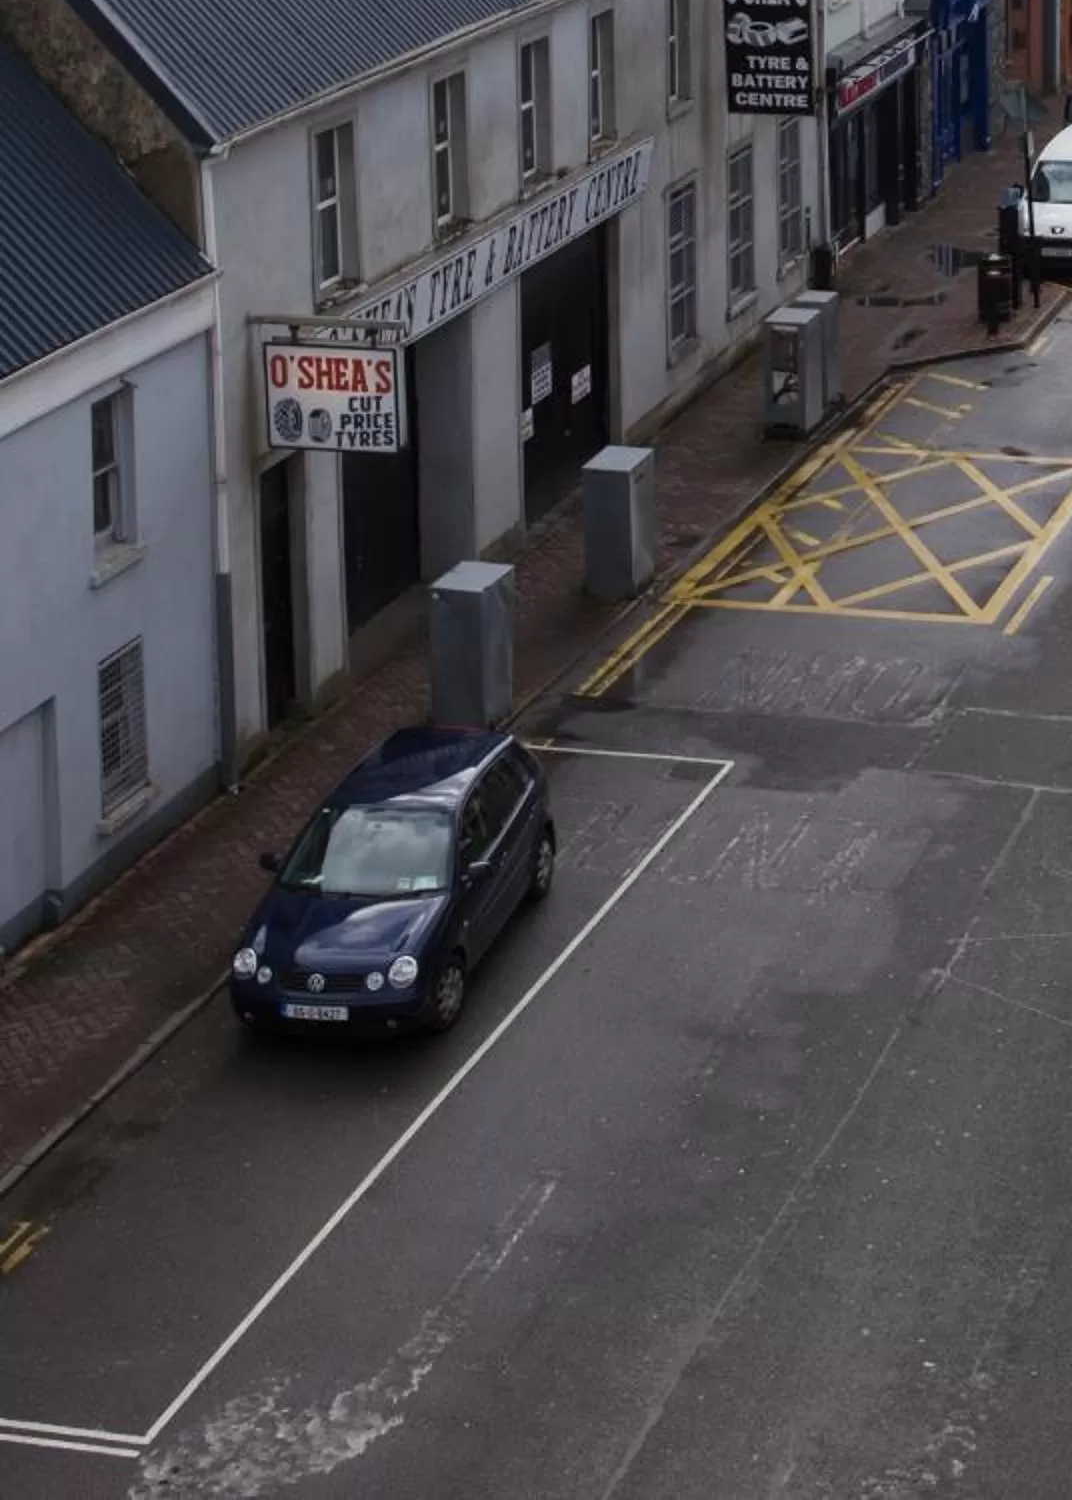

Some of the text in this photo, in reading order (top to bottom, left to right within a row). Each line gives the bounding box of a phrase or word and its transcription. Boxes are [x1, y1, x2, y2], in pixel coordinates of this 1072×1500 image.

[745, 55, 809, 71] TYRE &
[731, 72, 809, 90] BATTERY
[735, 91, 809, 108] CENTRE
[427, 248, 478, 323] TYRE
[484, 237, 497, 287] &
[502, 187, 578, 274] BATTERY
[584, 150, 642, 224] CENTRE
[270, 354, 391, 394] O'SHEA'S
[348, 395, 383, 413] CUT
[340, 412, 393, 430] PRICE
[335, 430, 394, 448] TYRES
